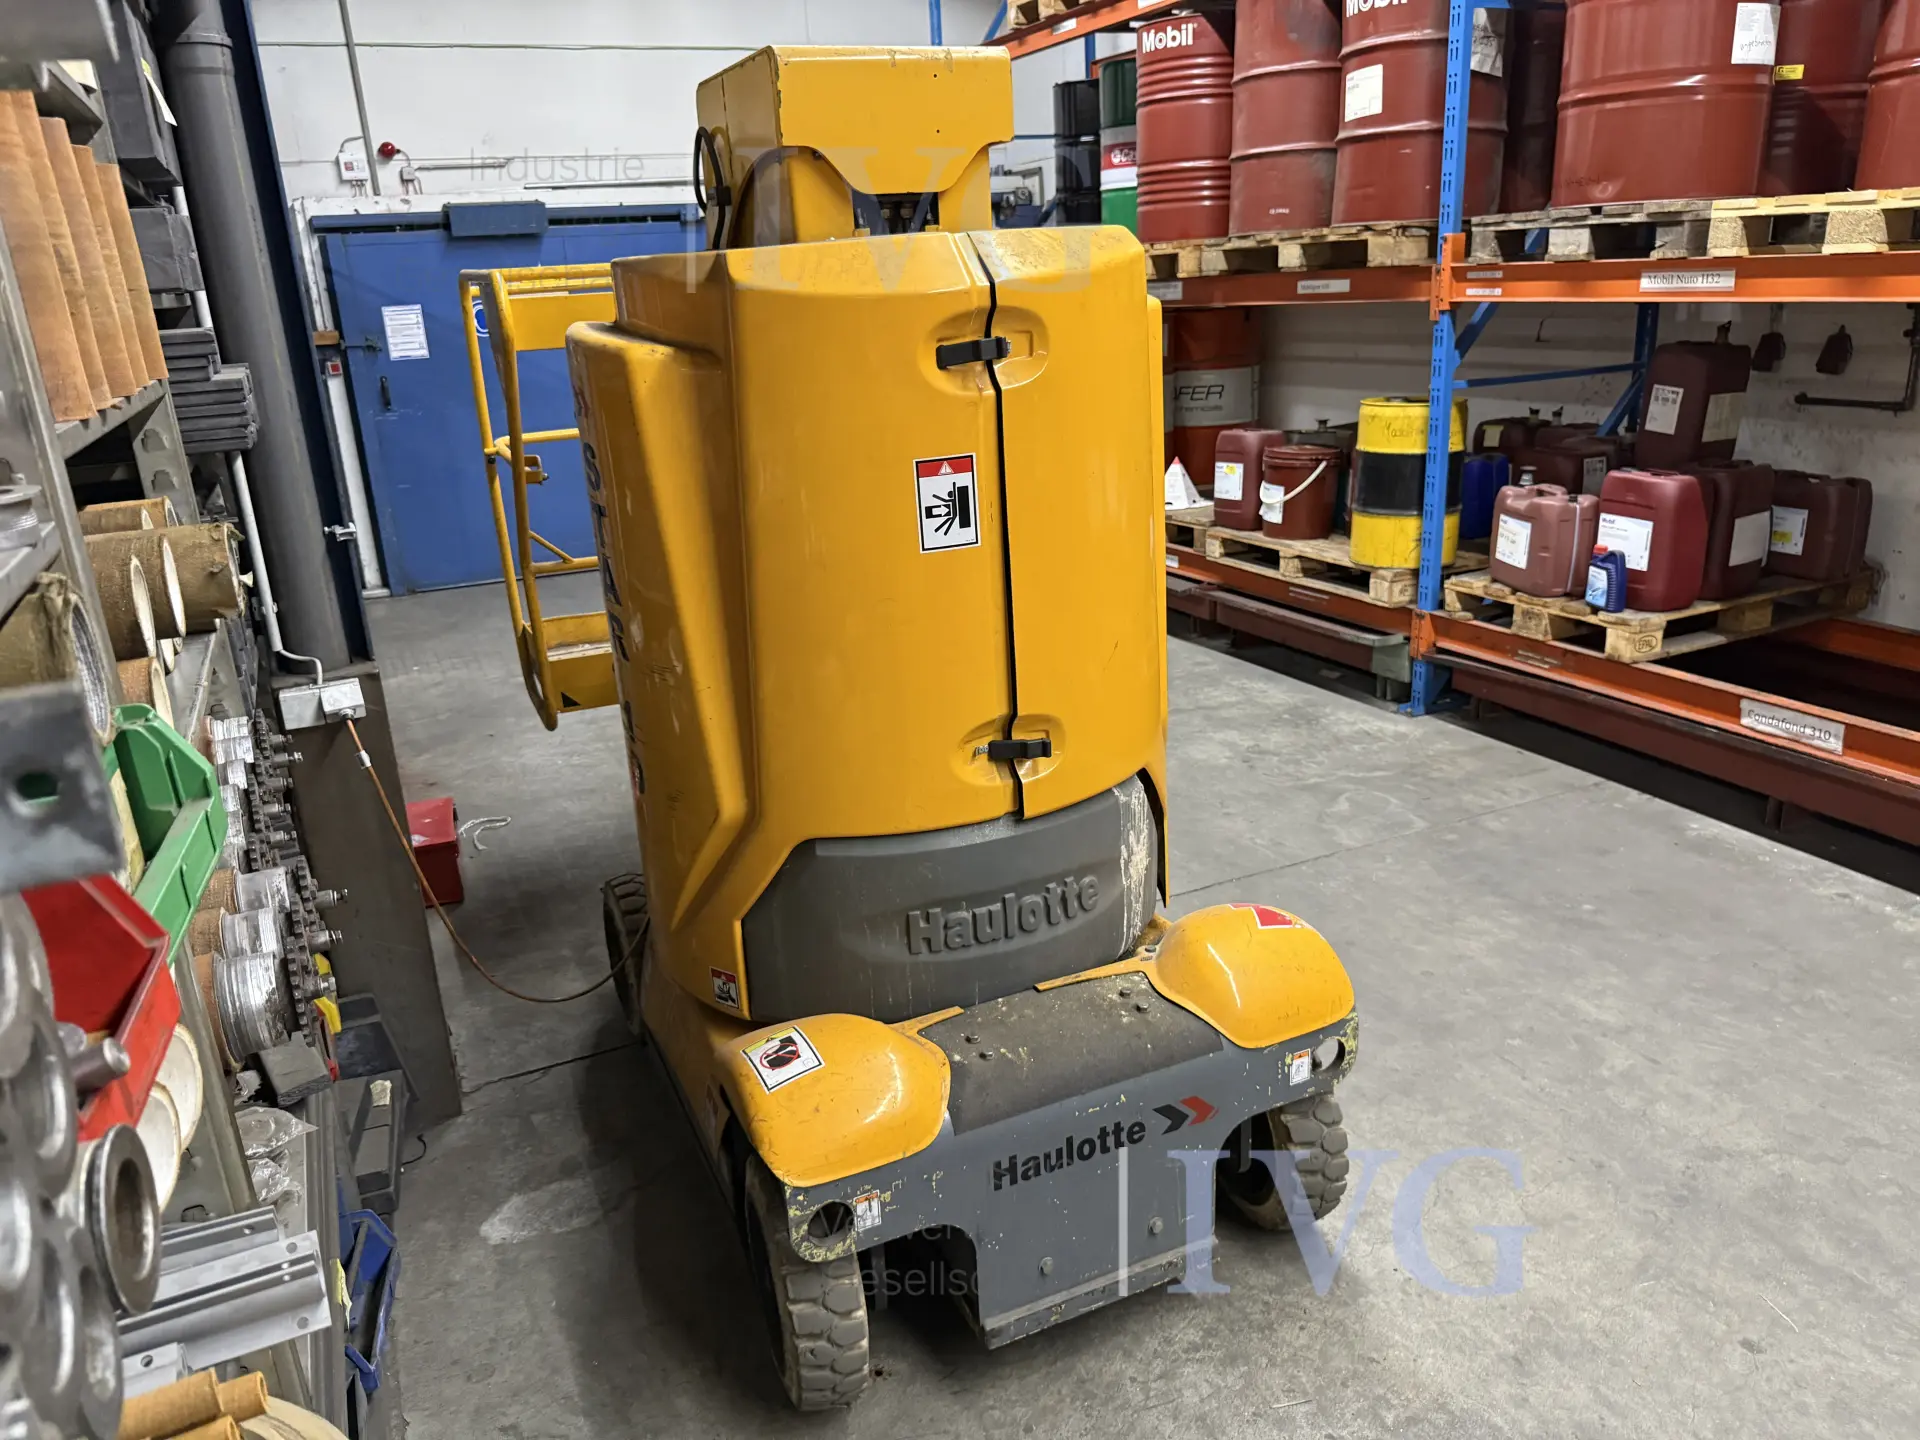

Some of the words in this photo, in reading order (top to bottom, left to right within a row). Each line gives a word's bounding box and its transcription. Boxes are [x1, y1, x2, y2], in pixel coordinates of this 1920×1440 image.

[1142, 23, 1195, 53] Mobil
[1647, 273, 1674, 285] Mobil
[1701, 272, 1721, 284] H32
[1809, 726, 1832, 741] 310
[907, 875, 1100, 955] Haulotte
[993, 1120, 1147, 1192] Haulotte
